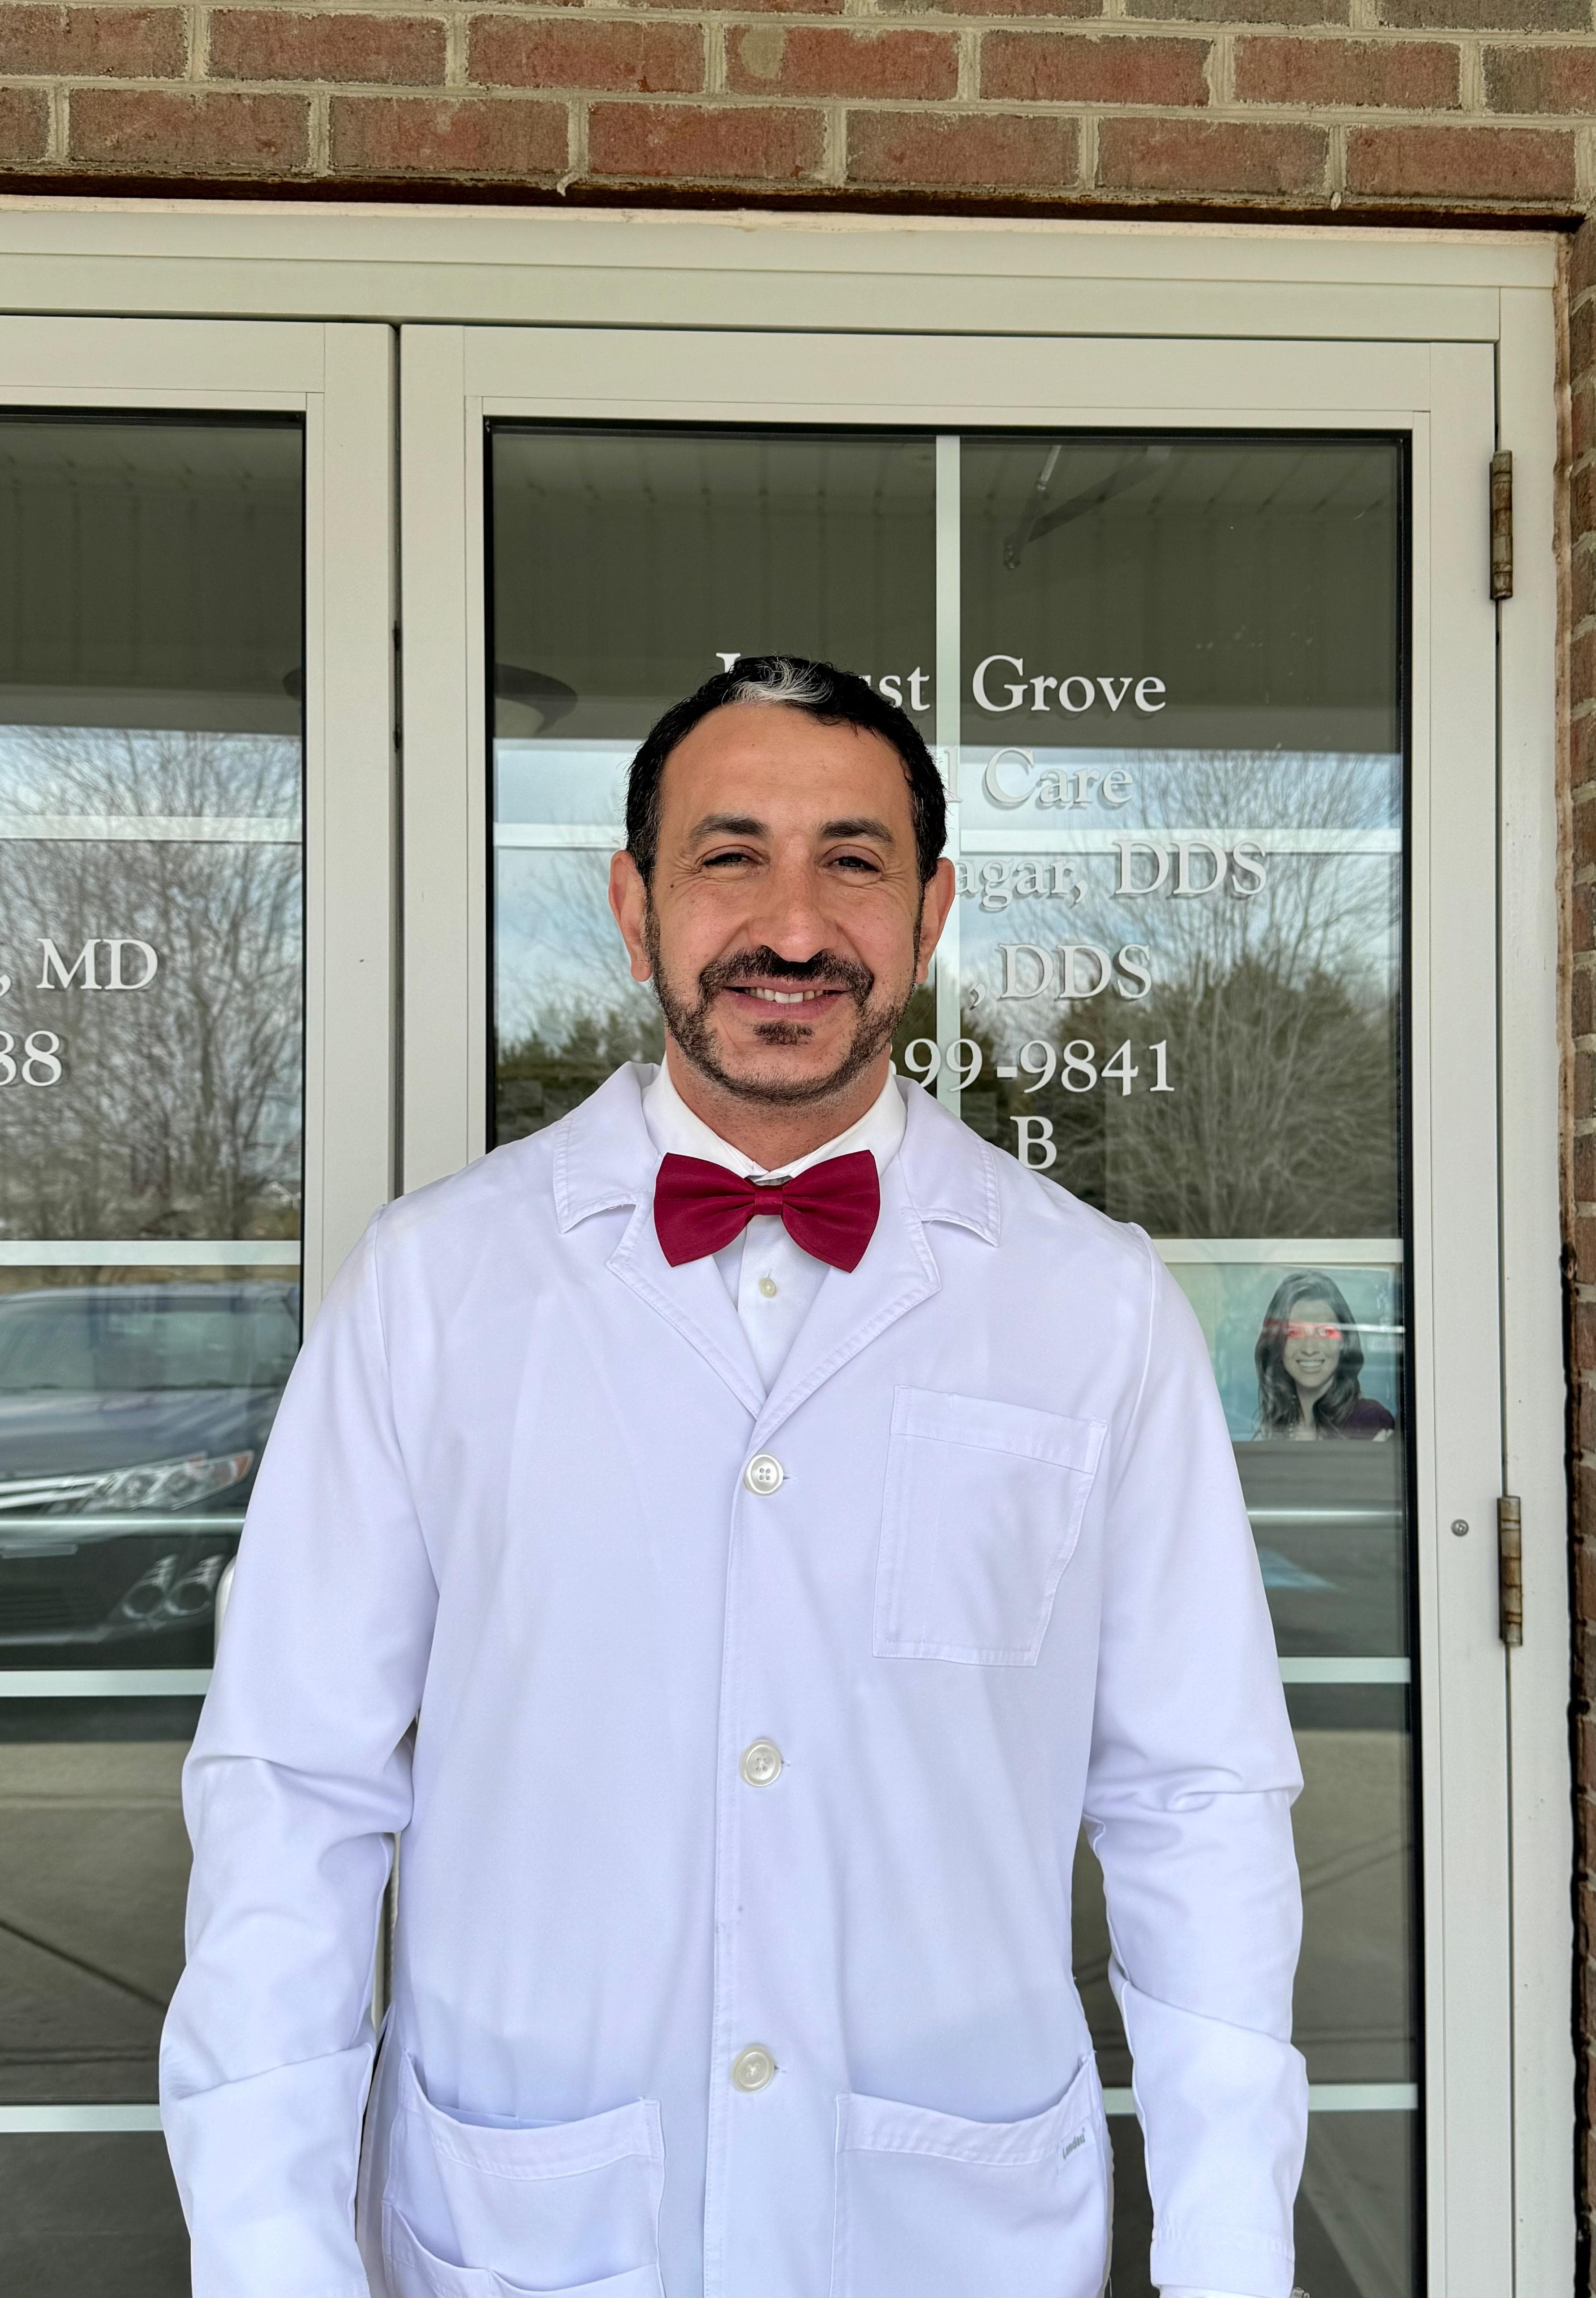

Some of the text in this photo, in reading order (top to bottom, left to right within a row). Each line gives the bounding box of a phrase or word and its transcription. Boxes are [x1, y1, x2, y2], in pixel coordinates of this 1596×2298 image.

[972, 654, 1166, 712] Grove
[985, 747, 1133, 804] Care
[954, 839, 1267, 908] agar, DDS
[36, 938, 158, 990] MD
[998, 943, 1152, 1000] DDS
[890, 1038, 1175, 1096] 99-9841
[1010, 1116, 1057, 1170] B
